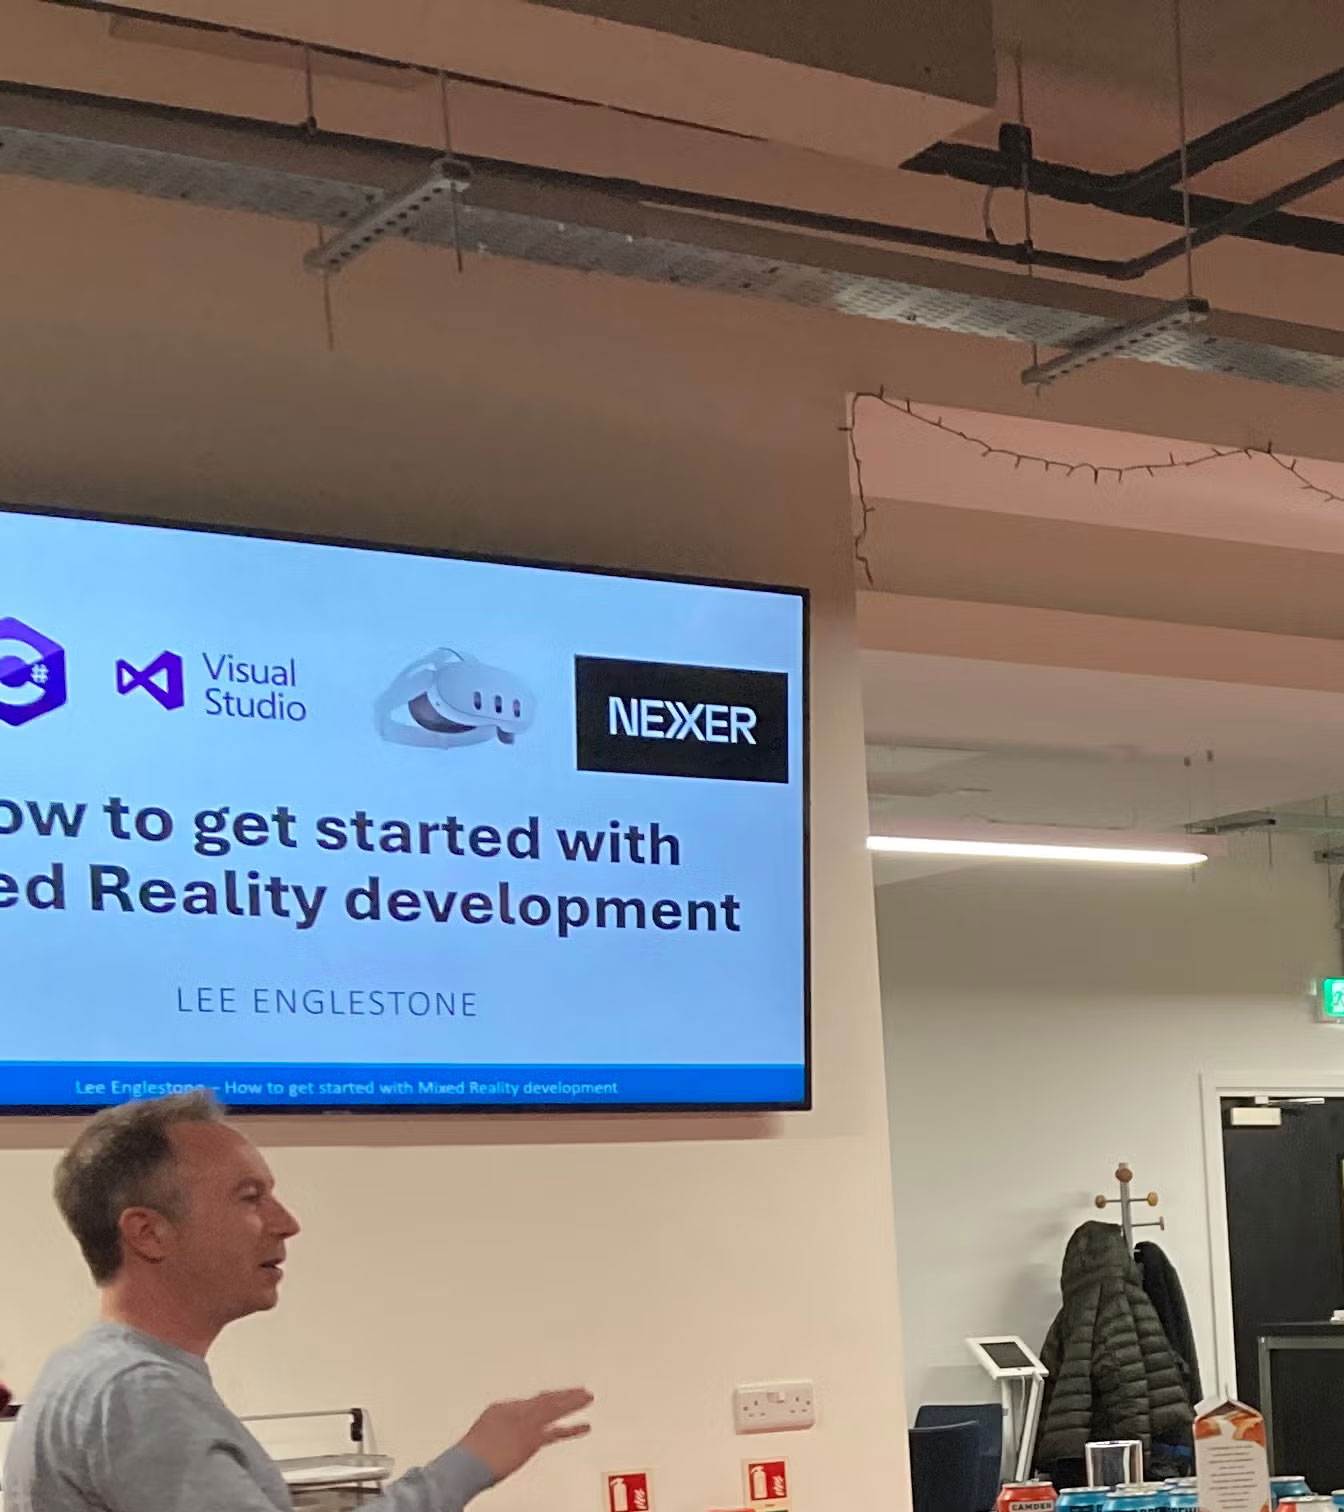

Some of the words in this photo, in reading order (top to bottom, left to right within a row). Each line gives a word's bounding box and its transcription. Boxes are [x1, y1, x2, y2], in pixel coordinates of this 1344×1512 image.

[202, 652, 297, 687] Visual
[205, 688, 307, 722] Studio
[103, 797, 174, 842] to
[194, 806, 298, 857] get
[315, 809, 540, 860] started
[556, 819, 681, 866] with
[89, 863, 328, 930] Reality
[345, 875, 741, 938] development
[177, 986, 237, 1014] LEE
[254, 988, 478, 1017] ENGLESTONE
[75, 1080, 106, 1095] Lee
[224, 1081, 263, 1095] How
[267, 1081, 284, 1095] to
[289, 1082, 316, 1098] get
[319, 1081, 375, 1095] started
[379, 1081, 413, 1095] with
[418, 1081, 465, 1095] Mixed
[469, 1081, 520, 1097] Reality
[523, 1081, 618, 1097] development
[1011, 1502, 1053, 1512] CAMDEN
